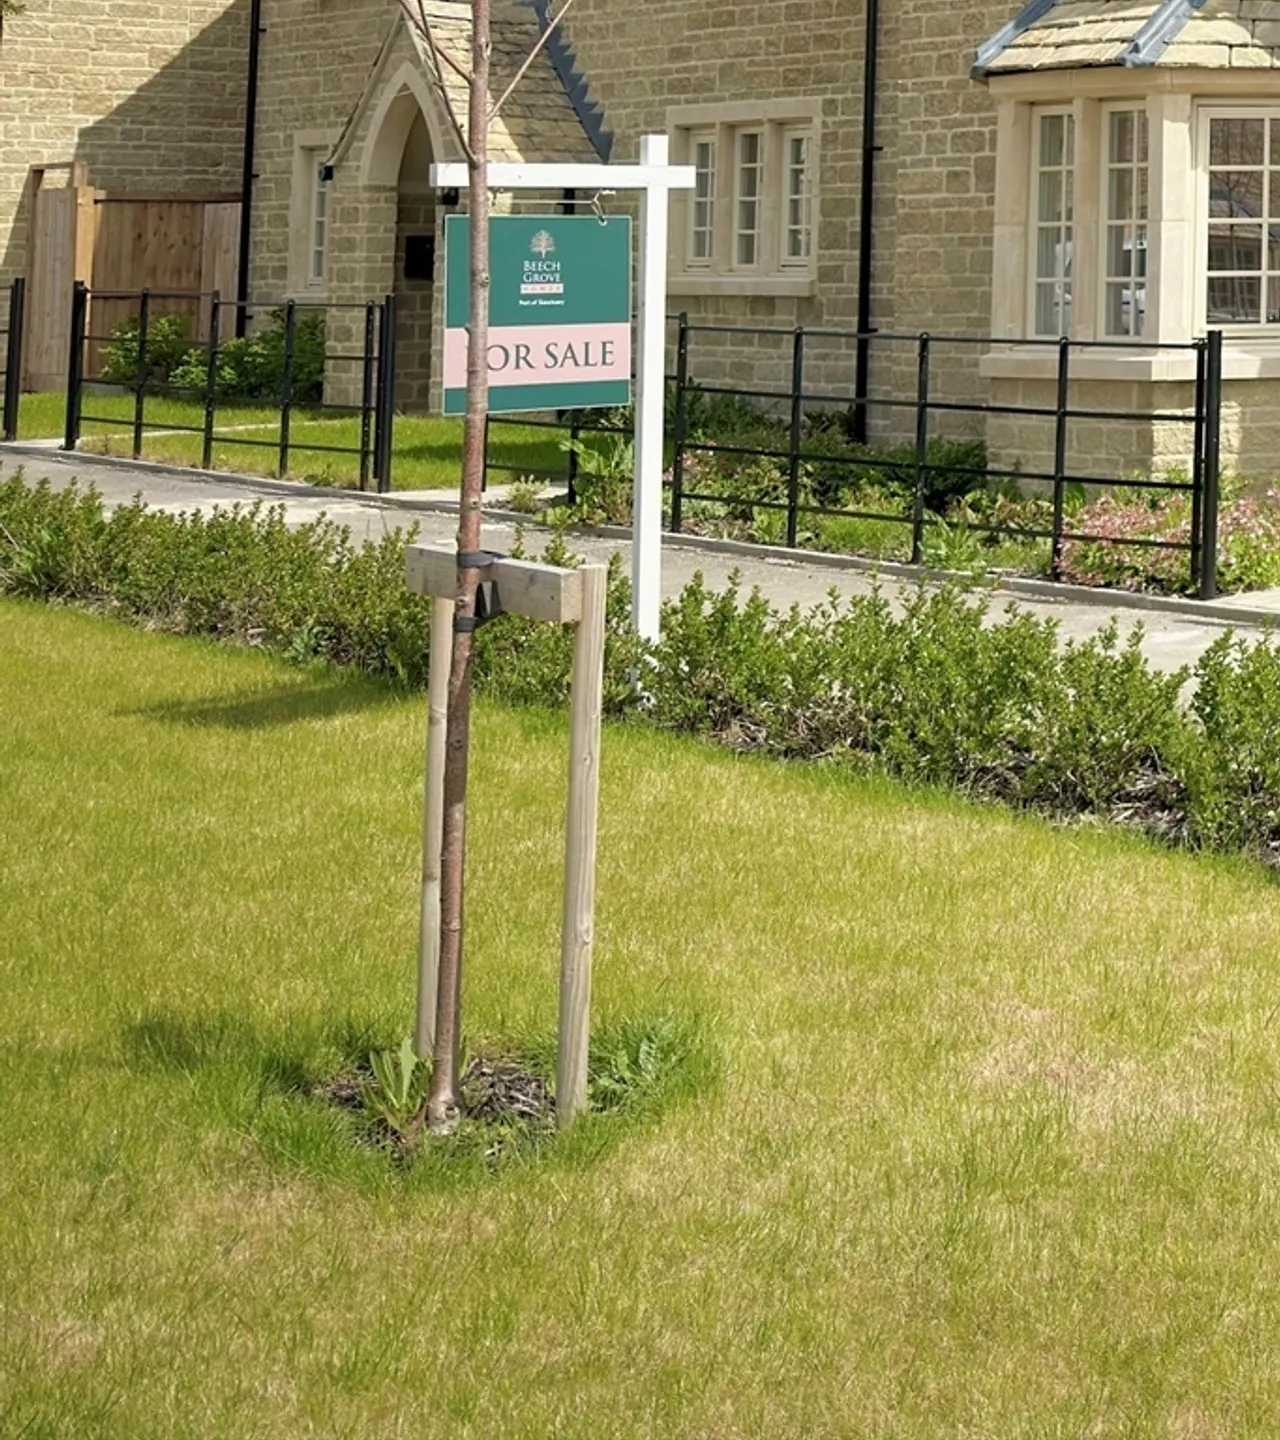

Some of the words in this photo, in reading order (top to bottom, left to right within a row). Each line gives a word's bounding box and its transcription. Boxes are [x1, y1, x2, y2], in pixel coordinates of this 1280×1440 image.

[523, 260, 560, 271] BEECH
[523, 272, 560, 282] GROVE
[466, 343, 535, 372] OR
[543, 340, 615, 369] SALE
